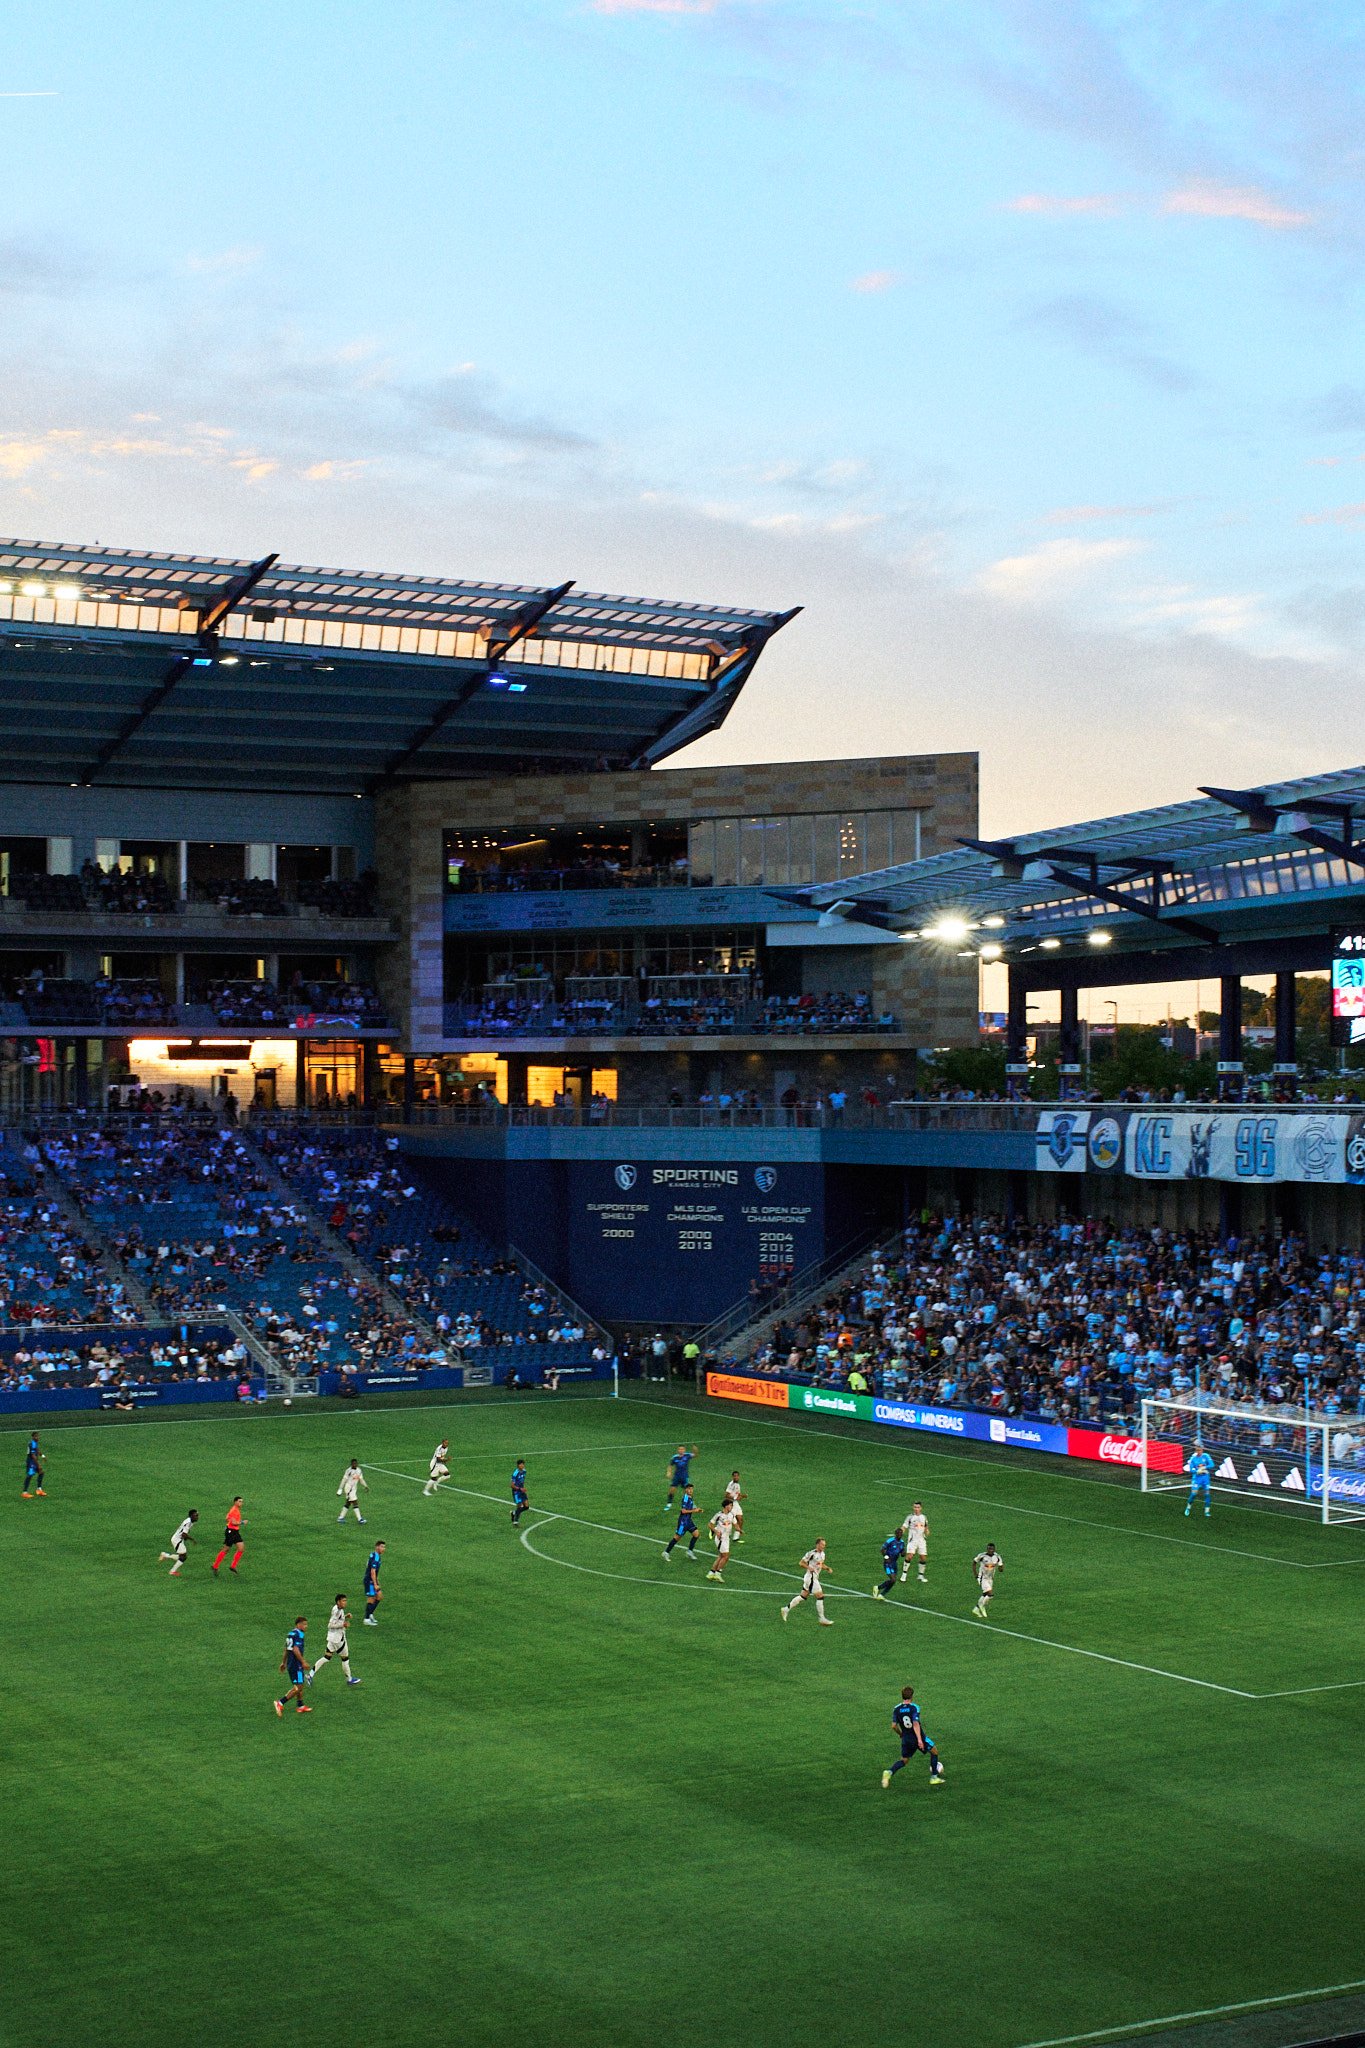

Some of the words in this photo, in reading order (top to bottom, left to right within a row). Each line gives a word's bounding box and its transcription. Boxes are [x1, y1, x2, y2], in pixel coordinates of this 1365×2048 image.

[1135, 1117, 1174, 1173] KC
[1235, 1118, 1278, 1176] 96
[652, 1169, 739, 1185] SPORTING
[586, 1203, 650, 1212] SUPPORTERS
[696, 1205, 717, 1213] CUP
[741, 1206, 758, 1214] U.S.
[601, 1212, 635, 1220] SHIELD
[667, 1213, 724, 1222] CHAMPIONS
[747, 1215, 806, 1223] CHAMPIONS
[602, 1229, 635, 1238] 2000
[678, 1230, 712, 1239] 2000
[759, 1232, 794, 1241] 2004
[678, 1241, 712, 1250] 2013
[759, 1243, 794, 1252] 2012
[759, 1254, 794, 1263] 2015
[759, 1264, 794, 1273] 207
[710, 1374, 757, 1398] Continental
[766, 1383, 786, 1401] Tire
[814, 1396, 838, 1409] Central
[838, 1399, 857, 1412] Bank
[875, 1404, 916, 1424] COMPASS
[920, 1412, 964, 1431] MINERALS
[1098, 1435, 1144, 1464] Coca-Cola
[902, 1715, 913, 1729] 8
